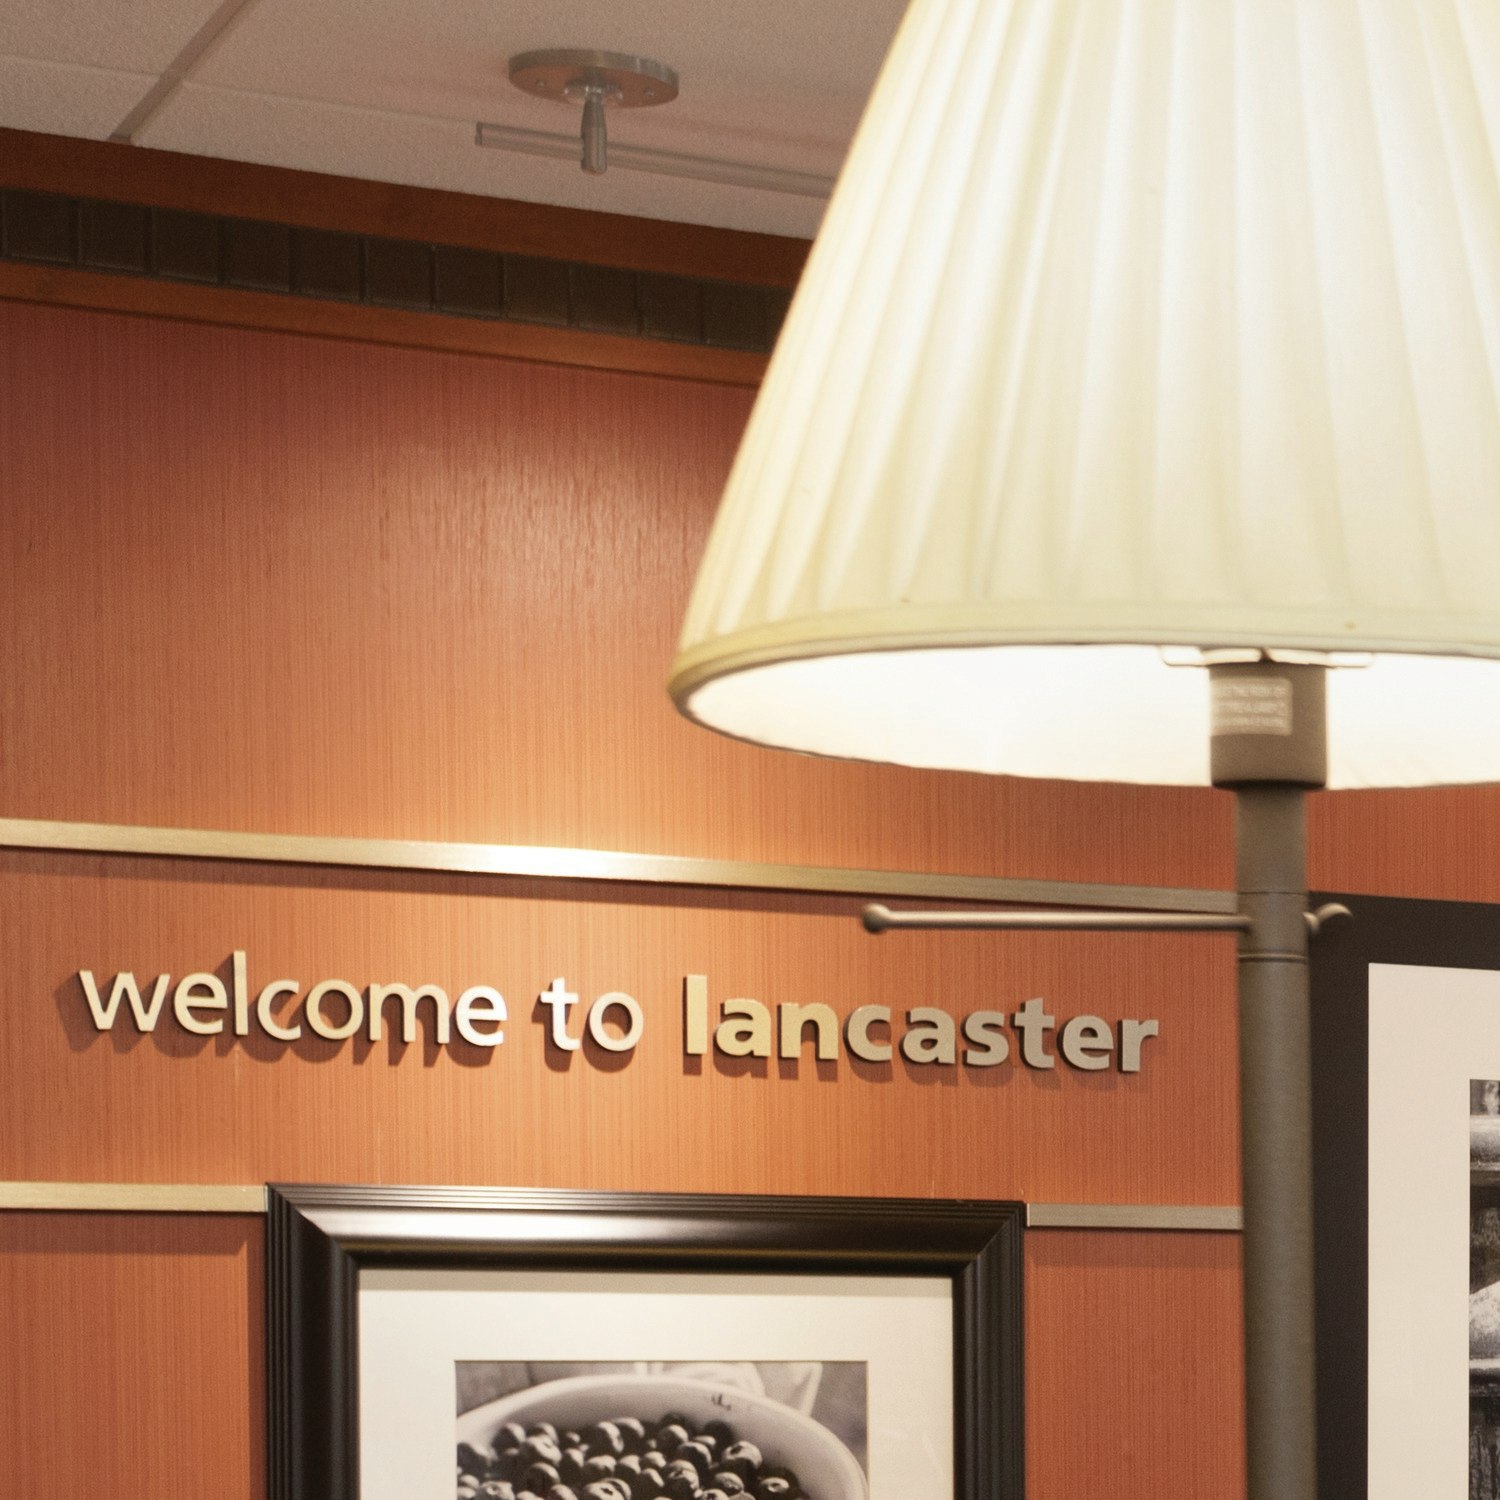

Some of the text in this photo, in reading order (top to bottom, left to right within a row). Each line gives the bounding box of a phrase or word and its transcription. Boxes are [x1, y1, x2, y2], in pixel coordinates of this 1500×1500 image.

[78, 949, 1160, 1073] welcome to lancaster
